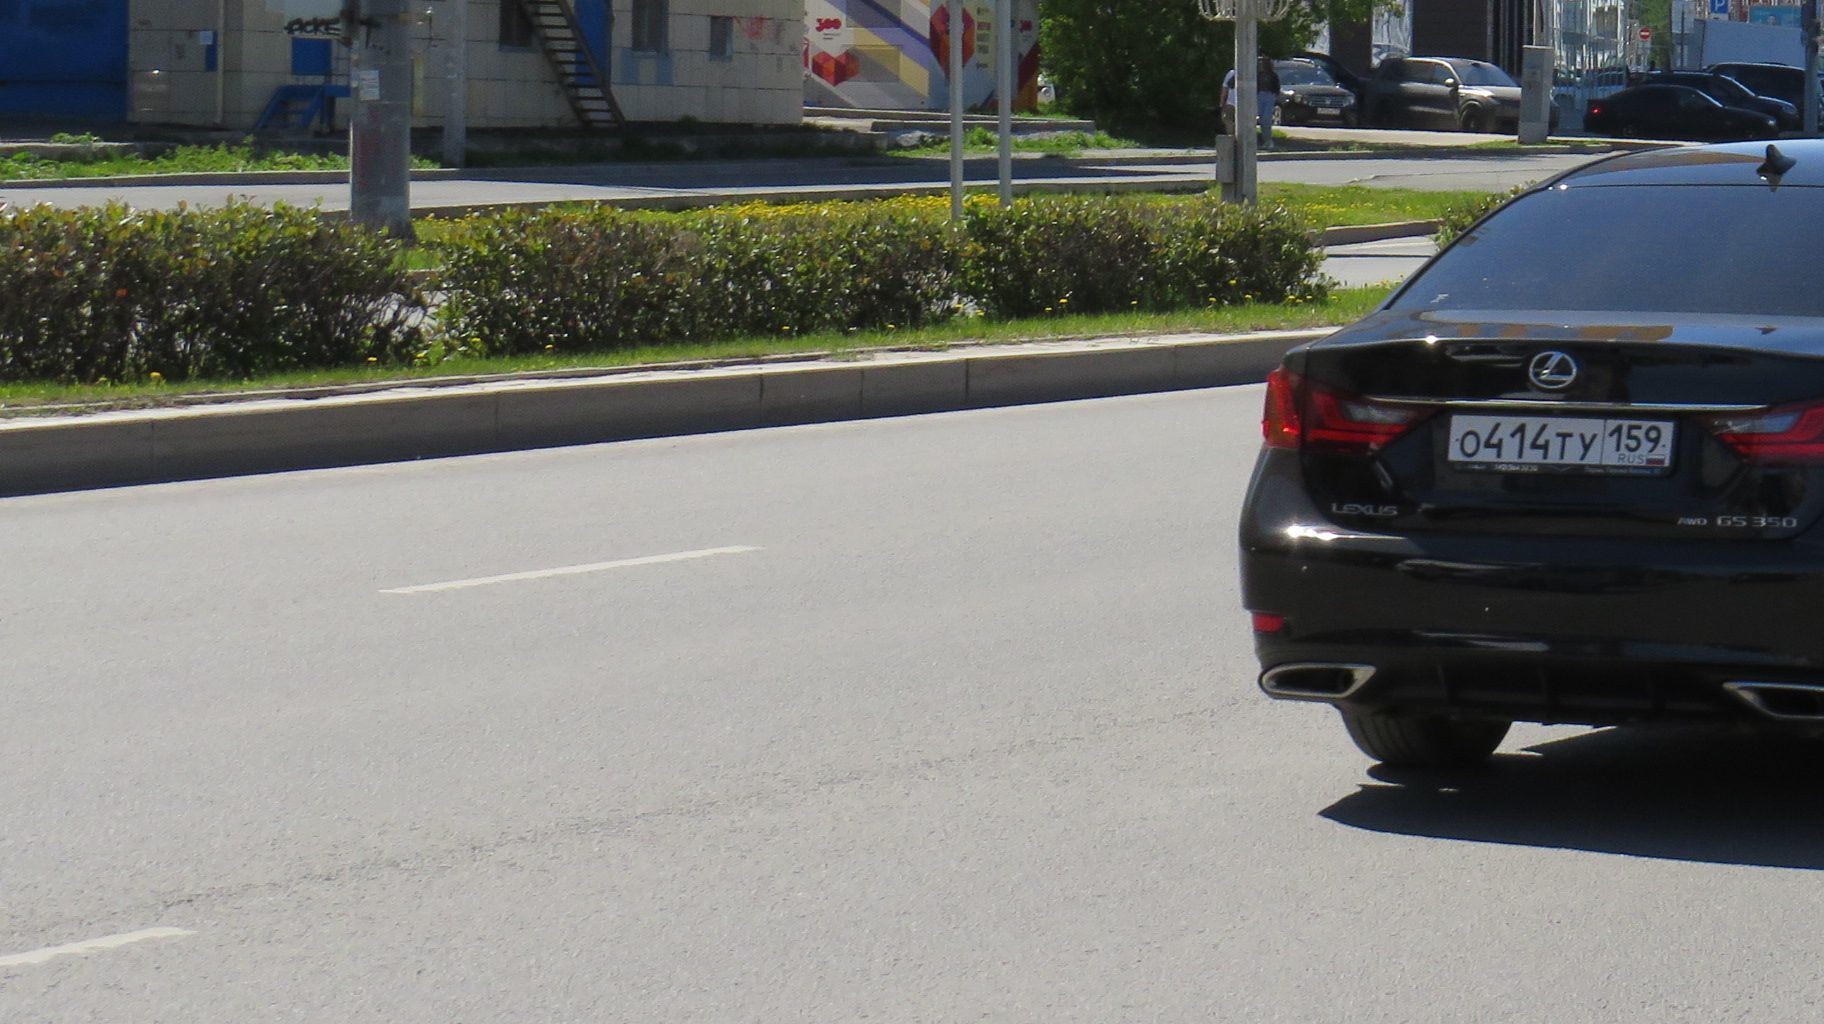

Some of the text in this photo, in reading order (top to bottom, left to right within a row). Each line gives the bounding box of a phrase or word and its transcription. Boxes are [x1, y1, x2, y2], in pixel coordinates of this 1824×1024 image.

[1459, 422, 1663, 461] О414ТУ 159
[1617, 453, 1645, 465] RUS
[1331, 502, 1398, 515] LEXUS
[1677, 516, 1798, 528] AWD GS 350
